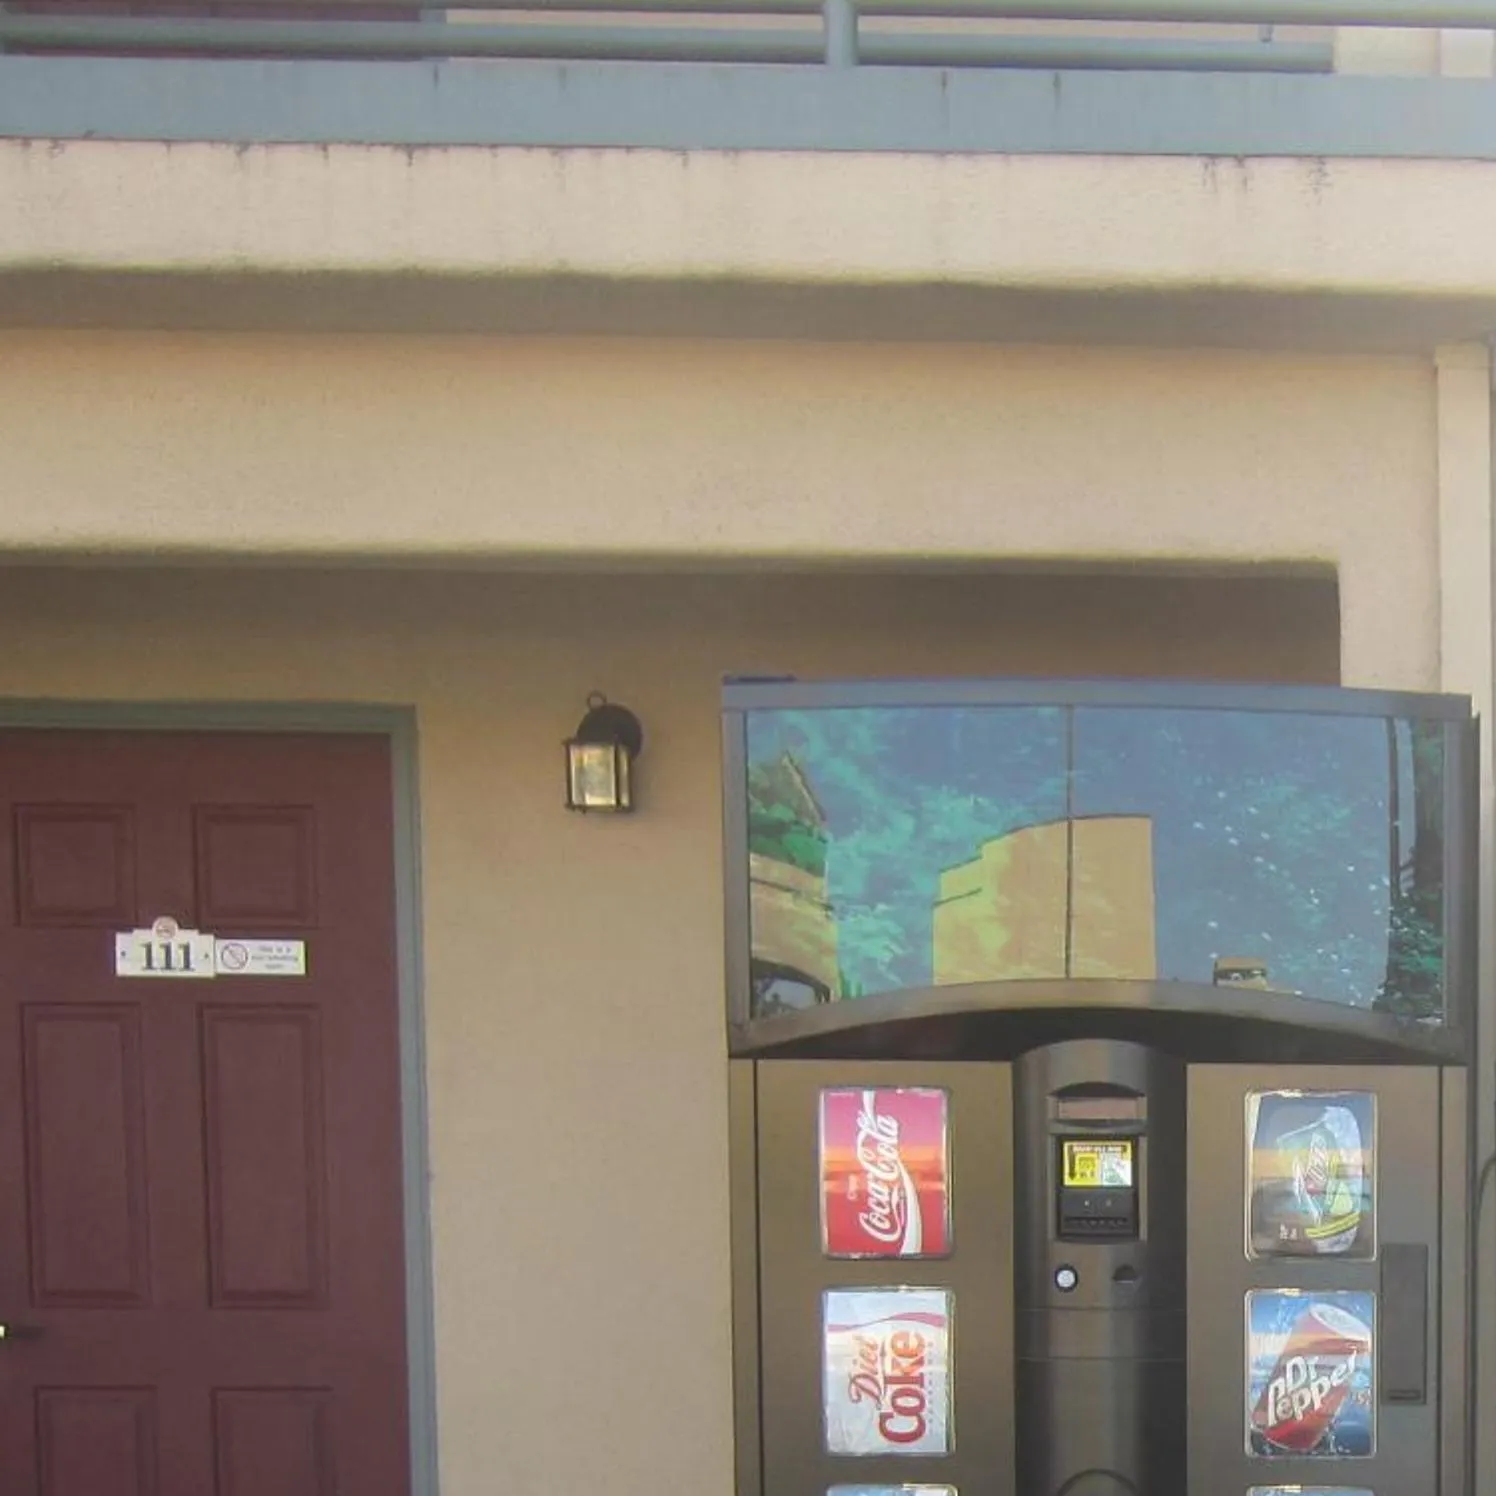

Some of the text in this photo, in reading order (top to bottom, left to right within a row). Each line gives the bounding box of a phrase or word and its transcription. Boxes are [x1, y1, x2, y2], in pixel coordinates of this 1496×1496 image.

[141, 940, 195, 971] 111
[878, 1330, 926, 1443] Coke
[1286, 1355, 1320, 1391] Dr
